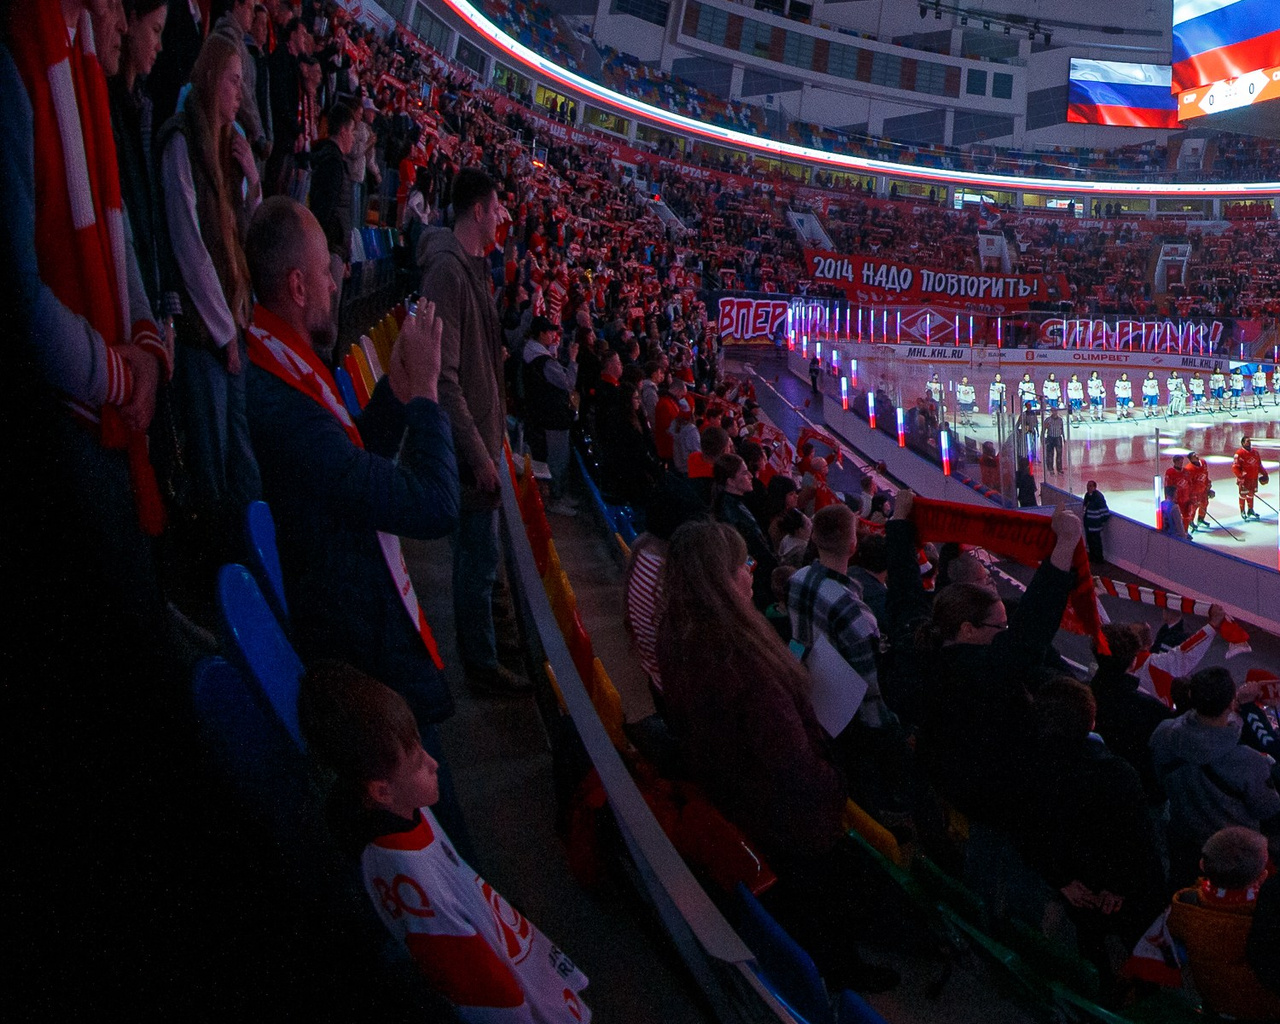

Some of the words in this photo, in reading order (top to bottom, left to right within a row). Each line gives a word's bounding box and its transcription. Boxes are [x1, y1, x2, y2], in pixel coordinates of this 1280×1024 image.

[812, 256, 854, 283] 2014
[861, 262, 914, 292] НАДО
[919, 268, 1038, 298] ПОВТОРИТЬ!
[906, 347, 964, 359] MHL.KHL.RU
[1073, 353, 1130, 362] OLIMPBET
